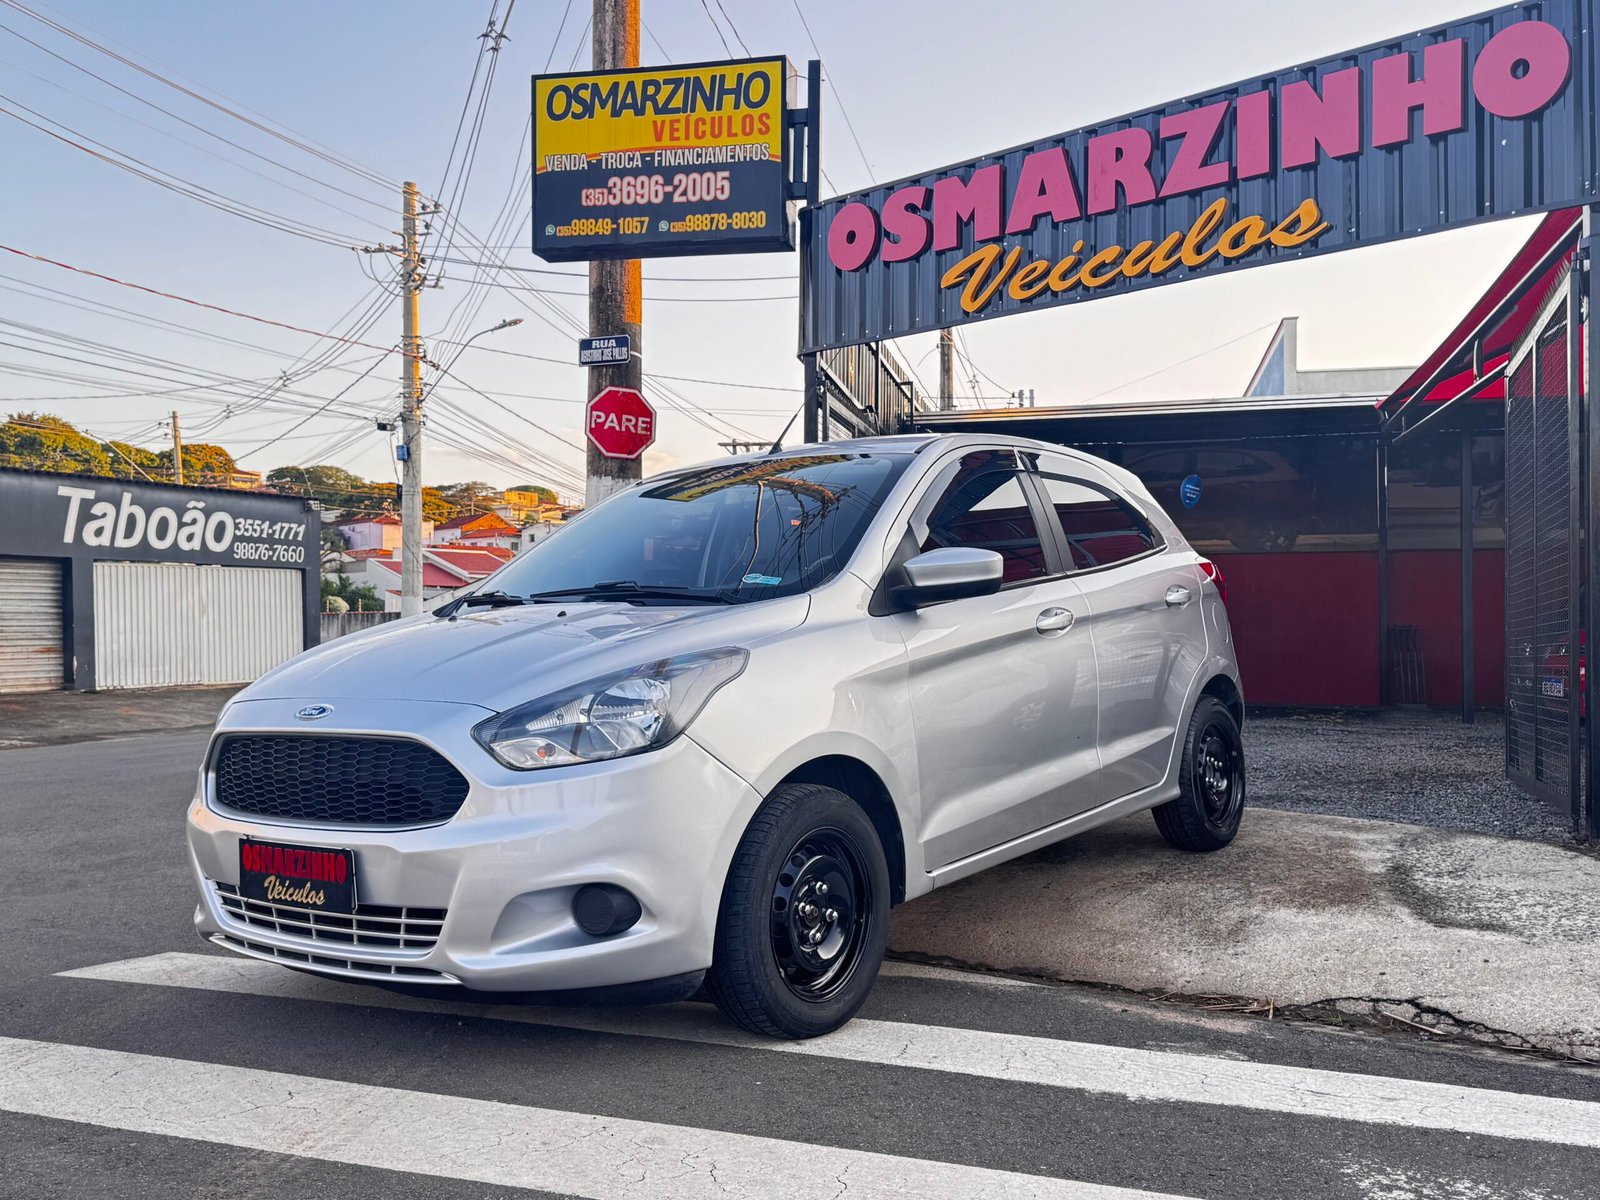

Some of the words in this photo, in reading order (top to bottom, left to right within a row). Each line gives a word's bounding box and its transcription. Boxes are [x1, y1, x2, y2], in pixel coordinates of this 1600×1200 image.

[546, 70, 771, 121] OSMARZINHO
[652, 112, 771, 142] VEÍCULOS
[545, 153, 588, 171] VENDA
[600, 151, 642, 169] TROCA
[654, 143, 770, 167] FINANCIAMENTOS
[827, 20, 1570, 271] OSMARZINHO
[581, 171, 730, 206] (35)3696-2005
[592, 339, 617, 348] RUA
[591, 410, 651, 435] PARE
[57, 485, 234, 553] Taboão
[242, 843, 348, 884] OSMARZINHO
